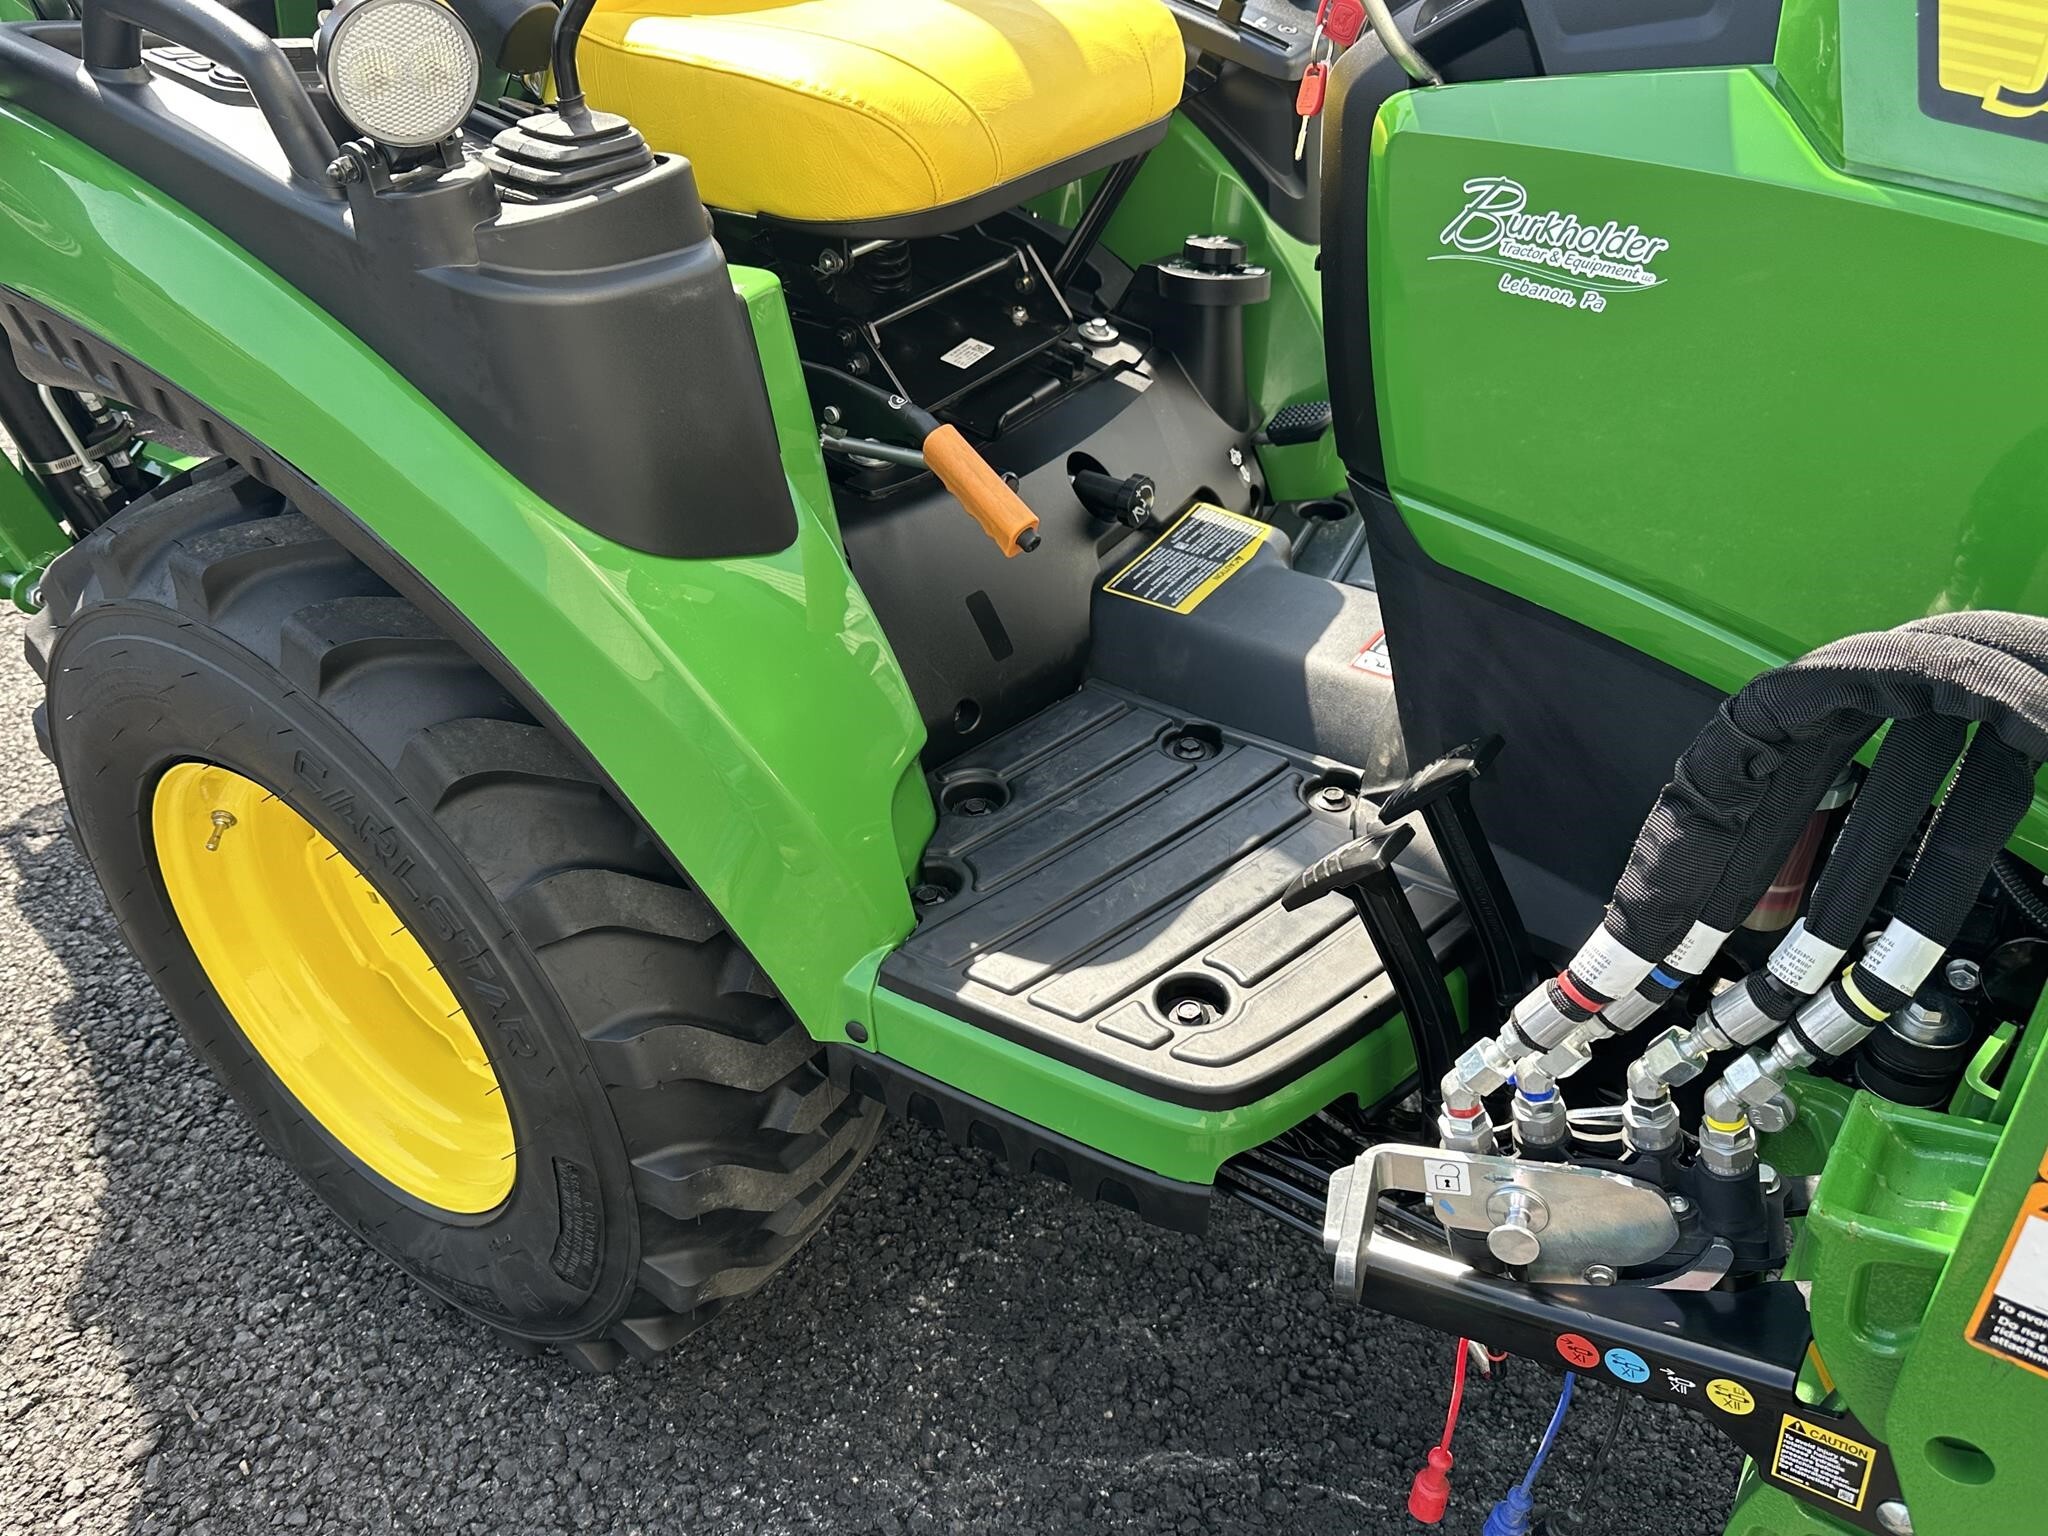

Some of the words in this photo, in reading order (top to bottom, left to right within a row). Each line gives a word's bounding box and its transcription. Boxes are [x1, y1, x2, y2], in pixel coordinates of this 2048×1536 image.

[1440, 177, 1668, 263] Burkholder
[1500, 239, 1546, 262] Tractor
[1548, 249, 1562, 266] &
[1563, 252, 1640, 280] Equipment
[1499, 274, 1576, 306] Lebanon,
[1580, 291, 1606, 312] Pa
[1998, 1300, 2015, 1314] To
[2017, 1310, 2048, 1328] avoi
[1993, 1326, 2036, 1348] riders
[1998, 1316, 2019, 1330] Do
[2021, 1327, 2046, 1342] not
[1990, 1335, 2048, 1365] attachm
[1784, 1432, 1793, 1441] To
[1810, 1430, 1867, 1458] CAUTION
